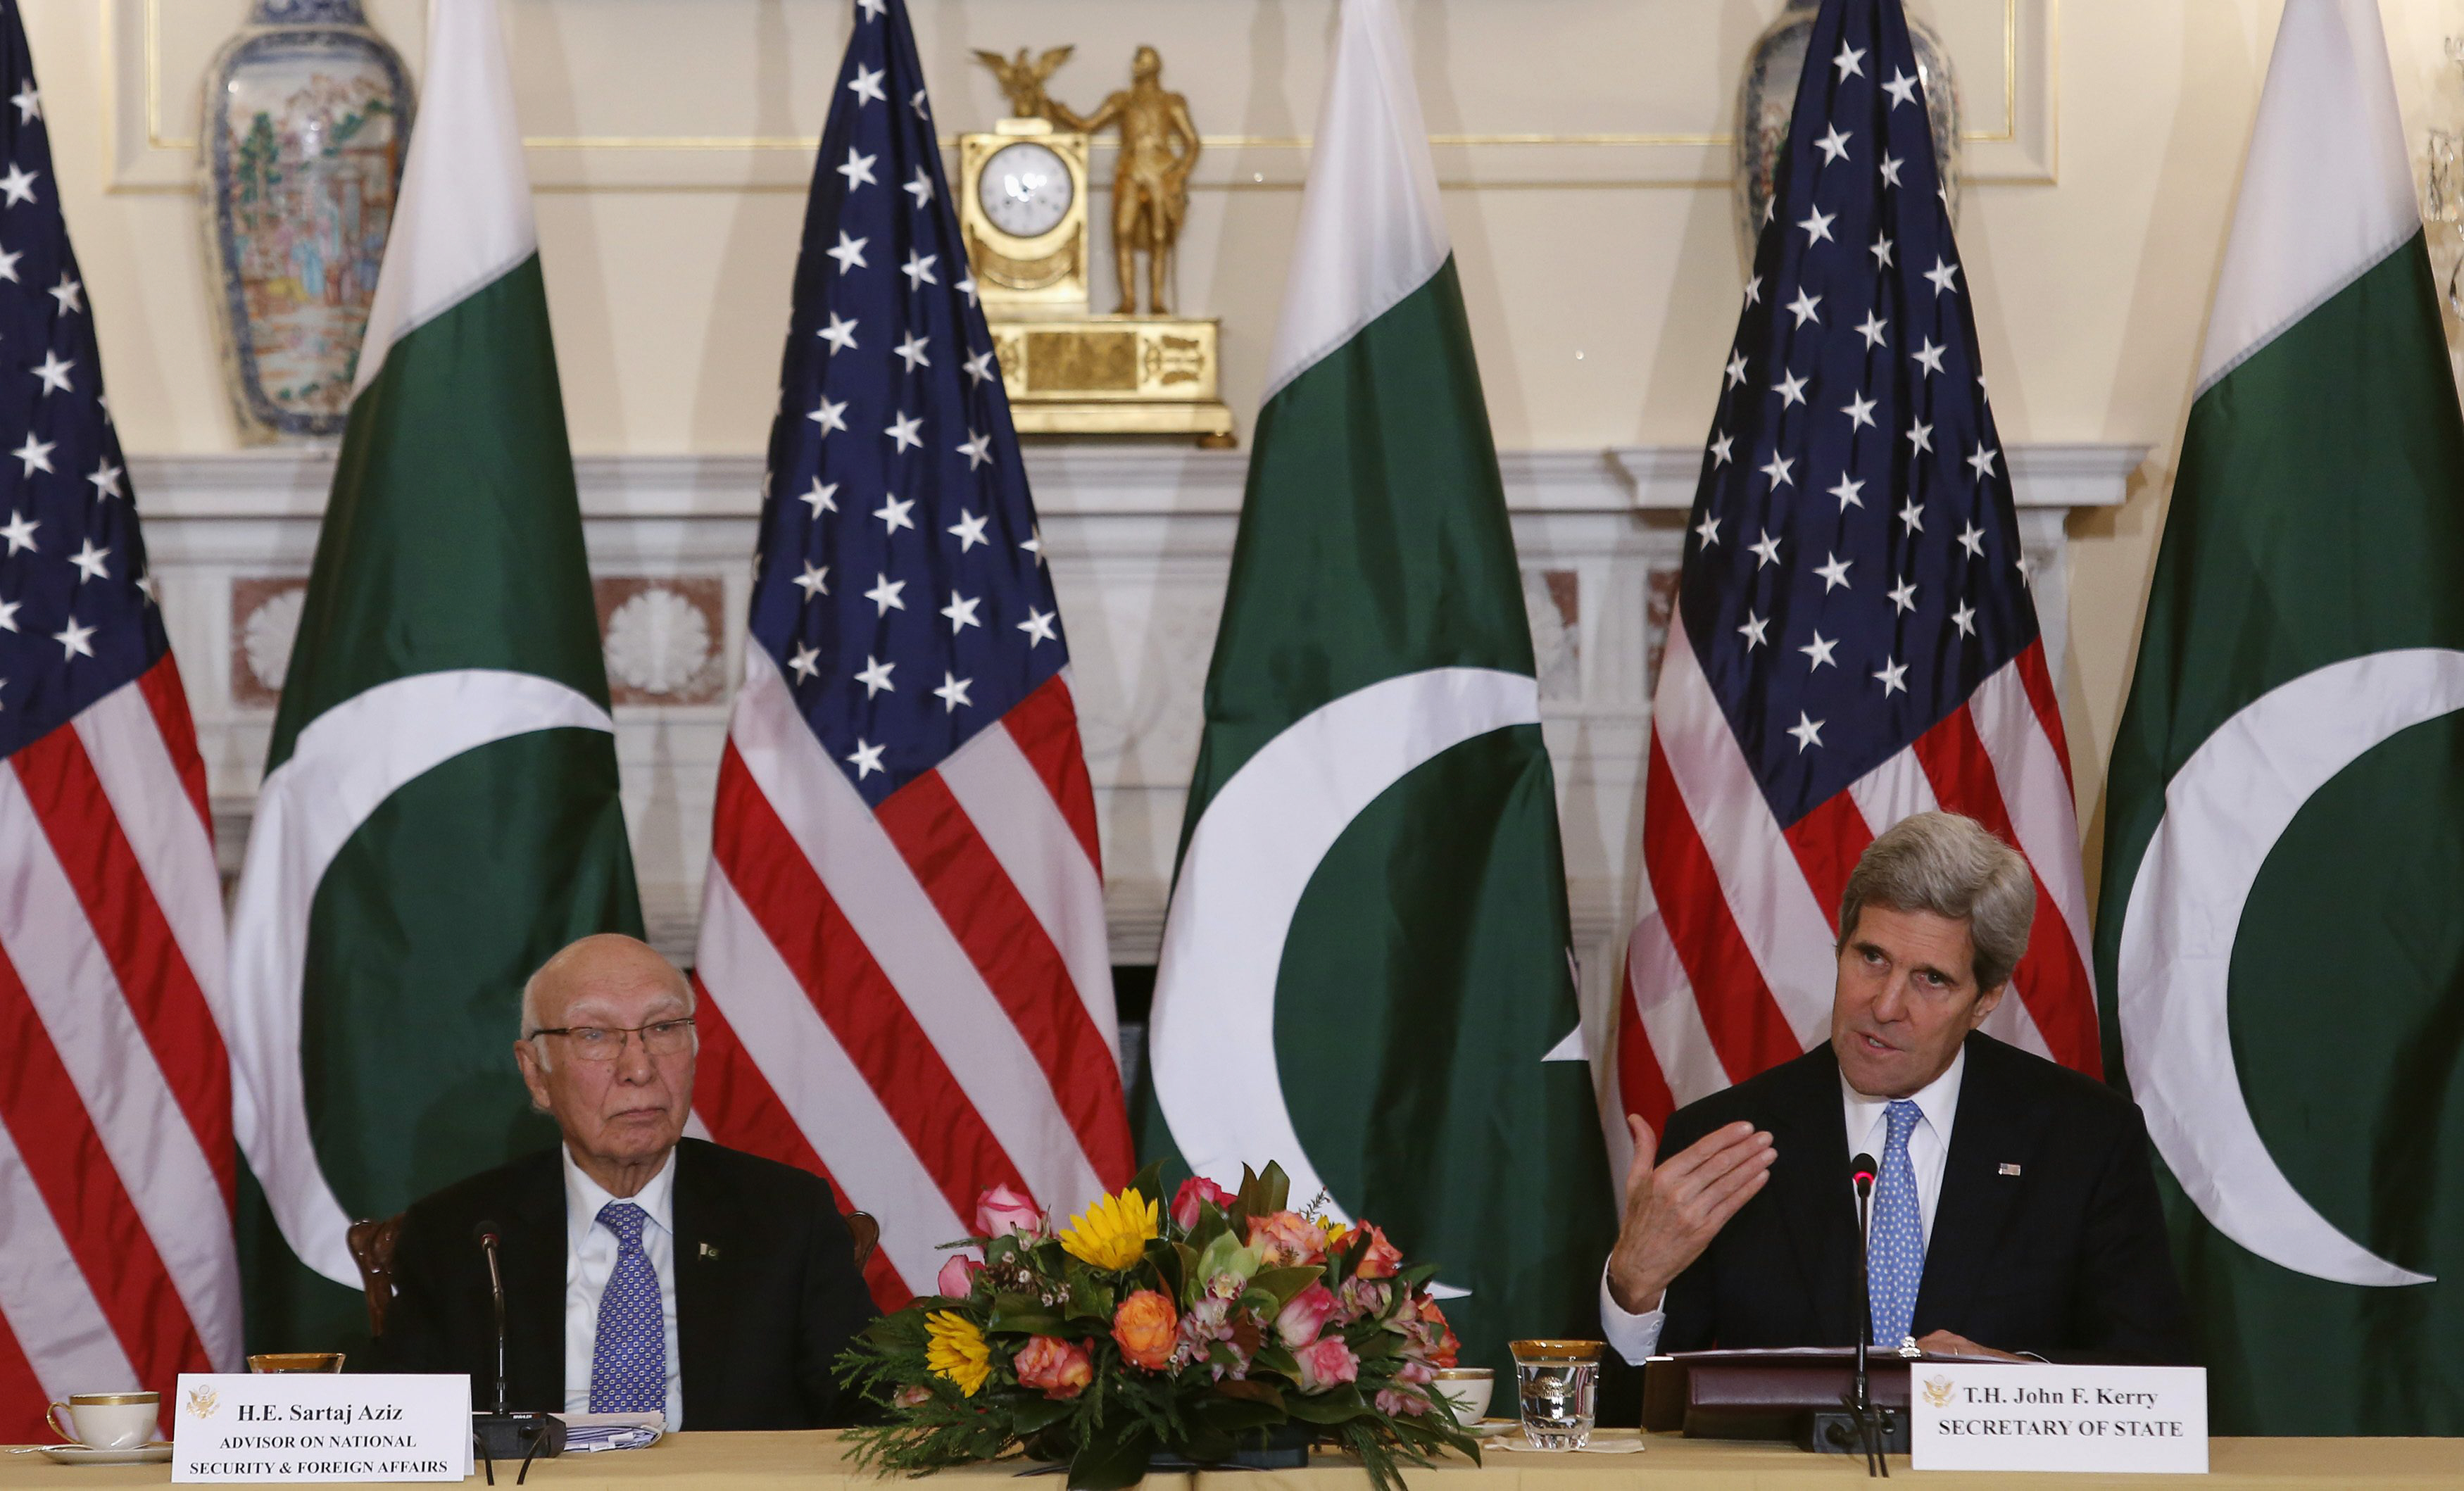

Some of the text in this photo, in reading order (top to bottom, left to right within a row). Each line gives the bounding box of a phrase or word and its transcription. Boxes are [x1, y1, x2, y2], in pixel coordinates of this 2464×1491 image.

[1963, 1388, 2158, 1409] T.H. John F. Kerry
[238, 1404, 403, 1426] H.E. Sartaj Aziz
[1939, 1420, 2183, 1437] SECRETARY OF STATE
[220, 1435, 417, 1449] ADVISOR ON NATIONAL
[189, 1461, 448, 1474] SECURITY & FOREIGN AFFAIRS
